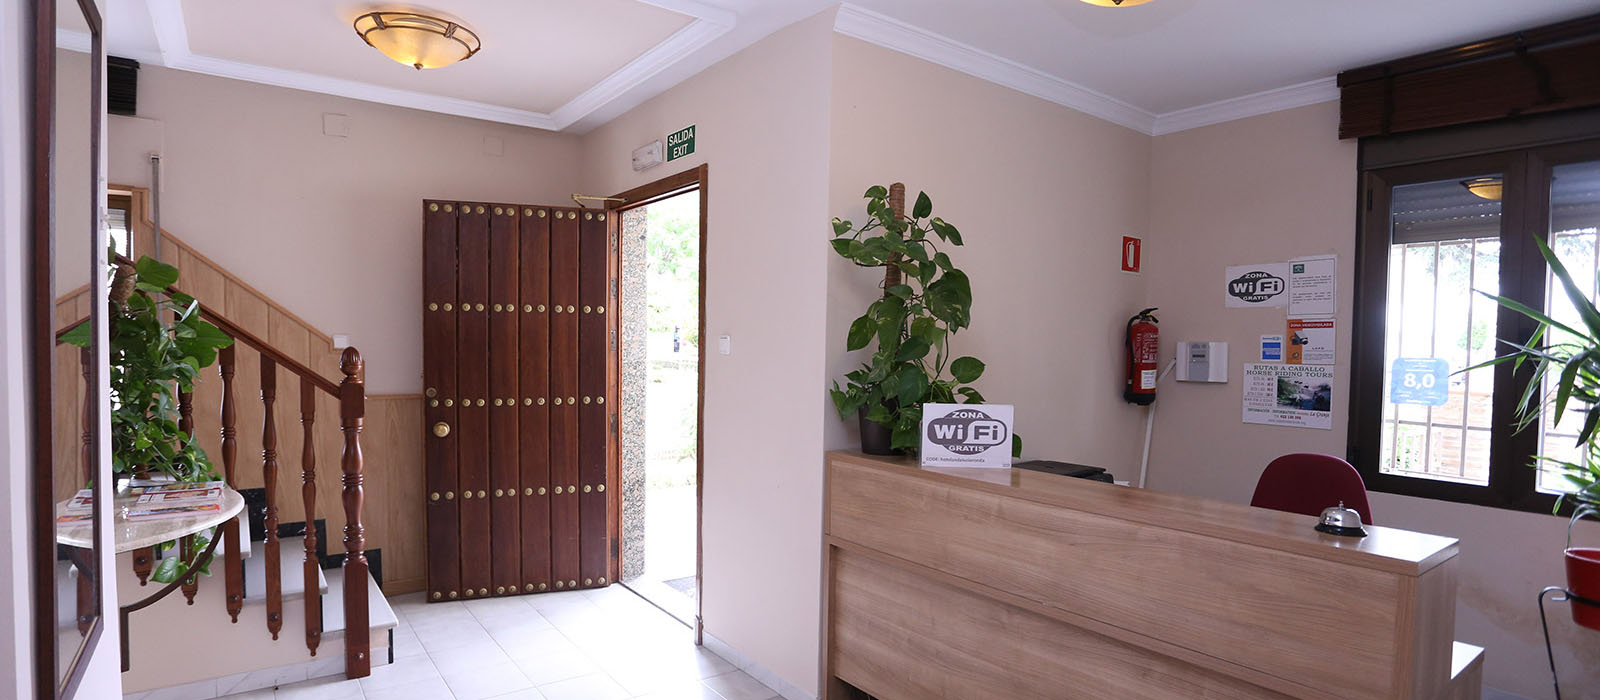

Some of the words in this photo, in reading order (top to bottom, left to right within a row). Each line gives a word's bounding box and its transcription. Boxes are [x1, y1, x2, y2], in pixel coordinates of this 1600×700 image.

[669, 128, 693, 147] SALIDA
[673, 143, 689, 159] EXIT
[1403, 373, 1435, 390] 8,0
[952, 411, 984, 419] ZONA
